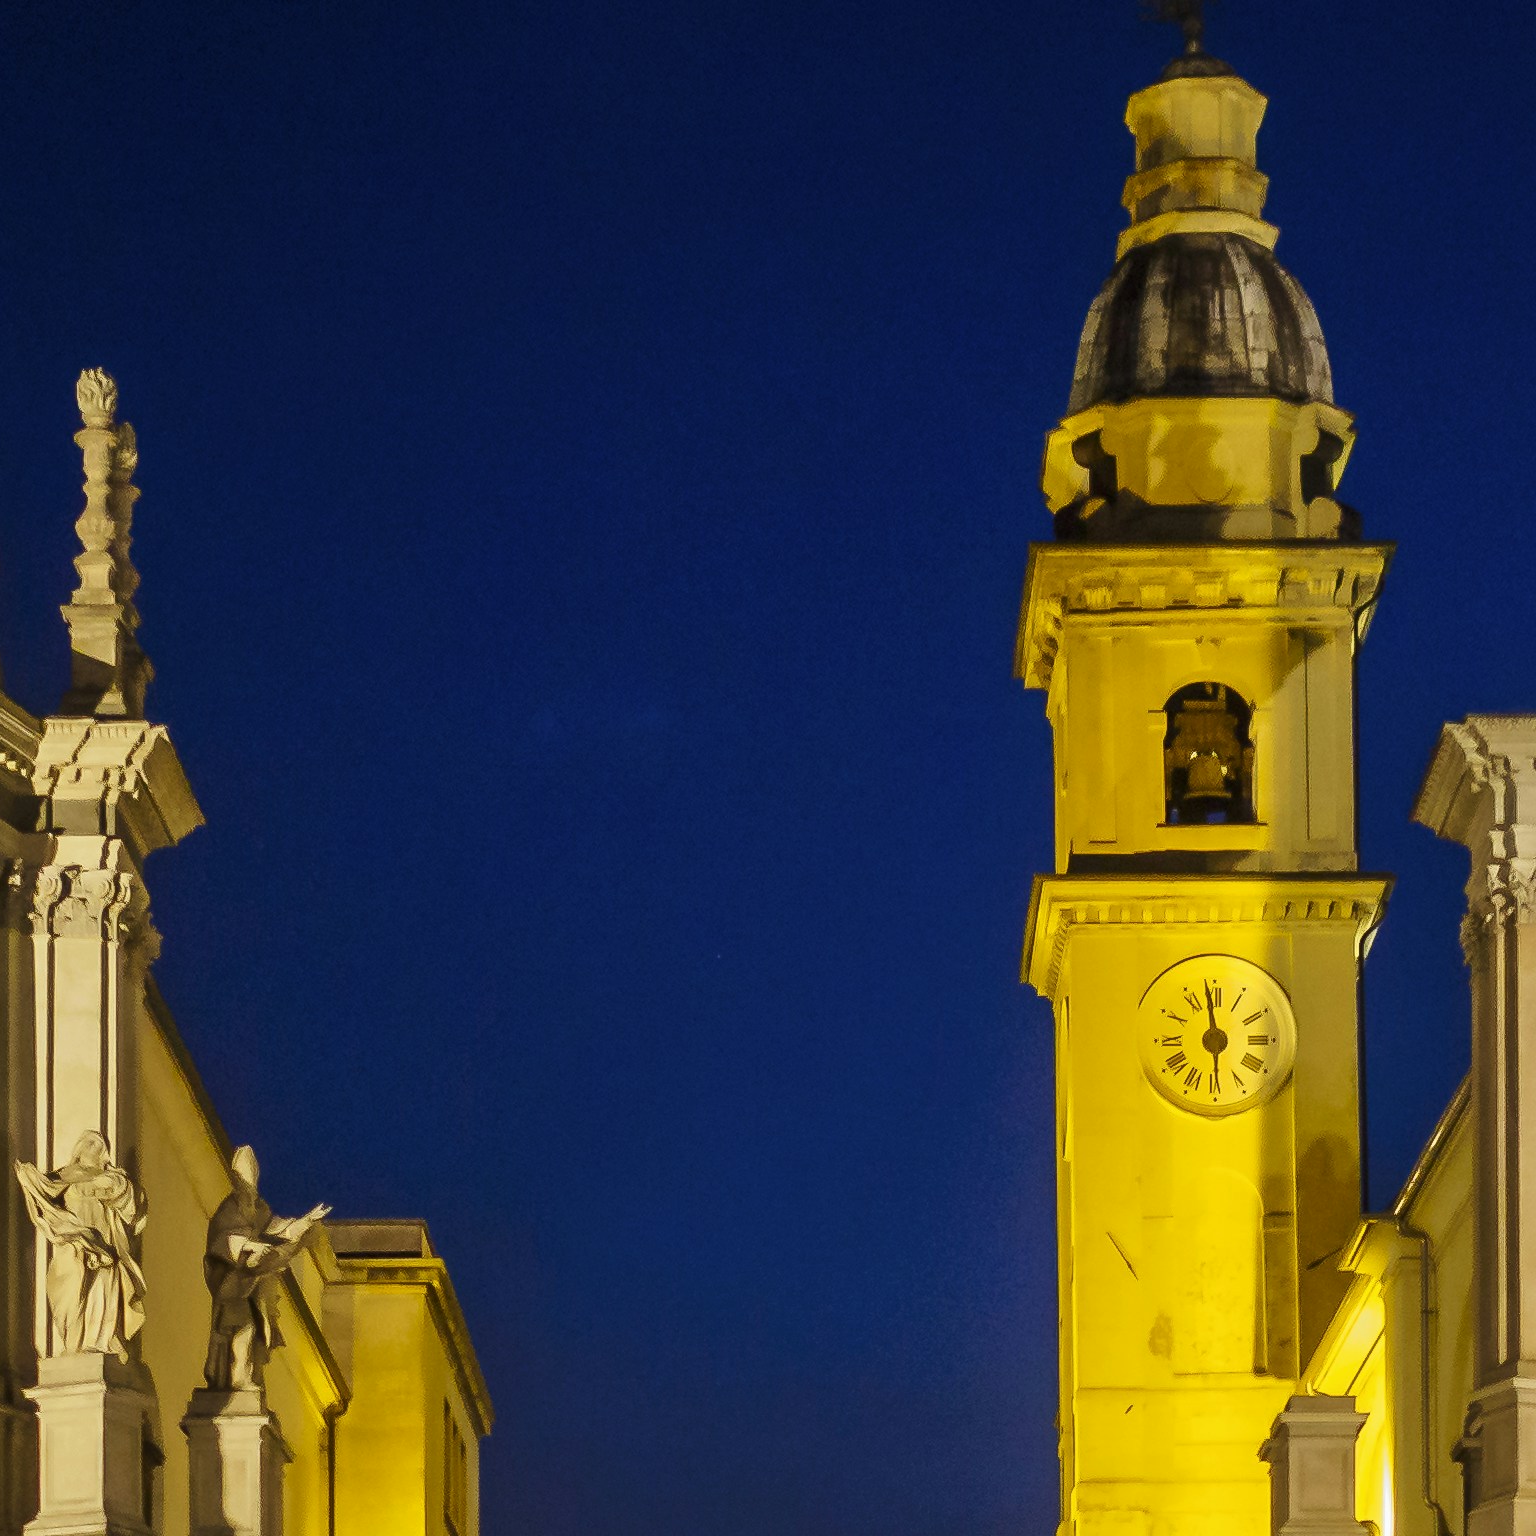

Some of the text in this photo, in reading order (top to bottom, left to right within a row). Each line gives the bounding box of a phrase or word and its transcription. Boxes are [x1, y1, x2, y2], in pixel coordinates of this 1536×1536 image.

[1230, 993, 1243, 1012] I
[1241, 1010, 1263, 1026] II
[1247, 1034, 1268, 1046] III
